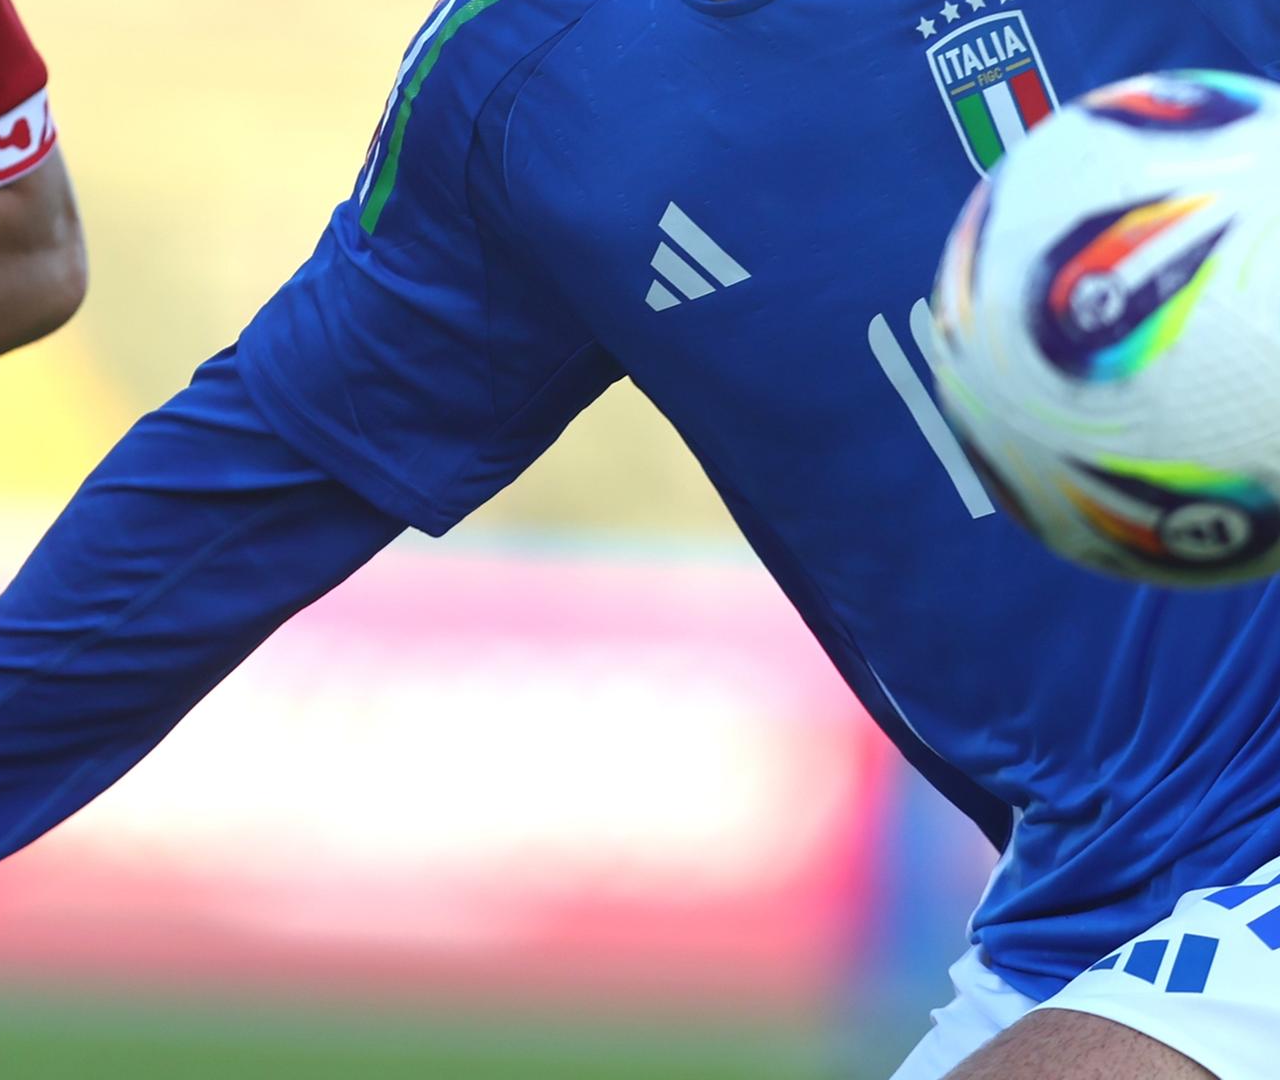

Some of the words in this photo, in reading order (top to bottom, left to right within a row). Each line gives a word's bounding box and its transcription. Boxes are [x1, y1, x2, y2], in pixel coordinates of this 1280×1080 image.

[937, 25, 1027, 85] ITALIA
[977, 67, 1004, 87] FIGC
[868, 297, 996, 520] 1
